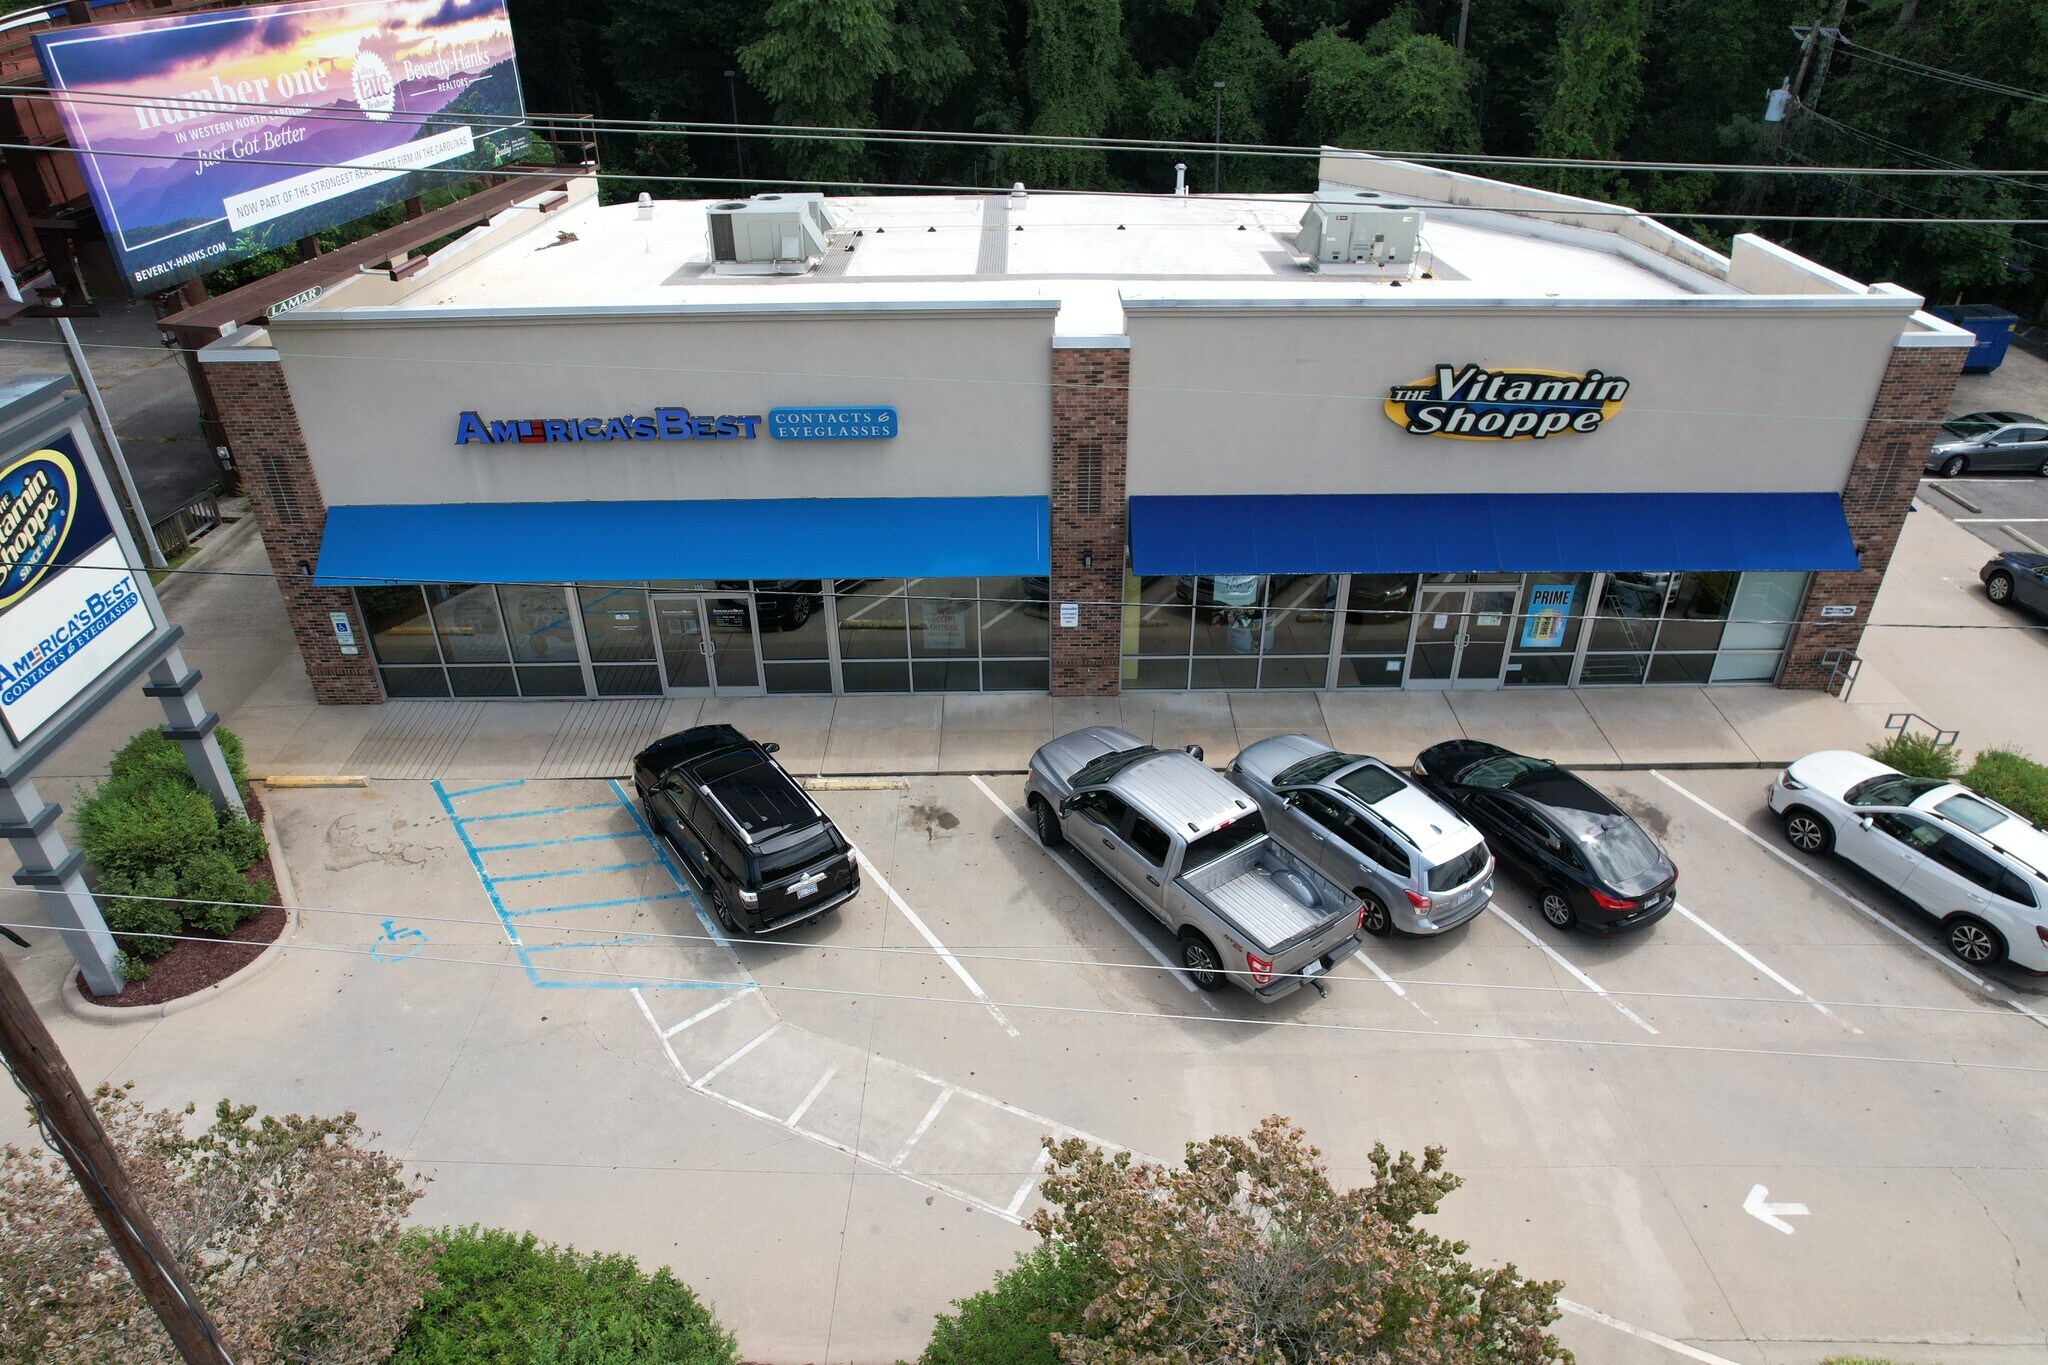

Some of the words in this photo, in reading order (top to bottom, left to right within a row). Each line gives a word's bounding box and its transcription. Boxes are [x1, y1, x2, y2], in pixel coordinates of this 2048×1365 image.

[403, 45, 490, 82] Beverly-Hanks
[134, 75, 269, 130] number
[277, 66, 329, 99] one
[356, 68, 391, 100] tate
[174, 131, 188, 144] IN
[189, 120, 235, 141] WESTERN
[235, 113, 267, 129] NORTH
[195, 142, 229, 176] Just
[232, 134, 260, 159] Got
[264, 125, 306, 151] Better
[236, 202, 258, 219] NOW
[260, 194, 281, 211] PART
[283, 190, 293, 203] OF
[294, 185, 310, 199] THE
[311, 169, 354, 194] STRONGEST
[355, 168, 372, 180] REAL
[372, 157, 397, 174] ESTATE
[397, 153, 414, 167] FIRM
[414, 151, 422, 161] IN
[422, 146, 434, 157] THE
[435, 135, 468, 154] CAROLINAS
[134, 241, 228, 283] BEVERLY-HANKS.COM
[270, 287, 317, 318] LAMAR
[1393, 388, 1432, 401] THE
[1437, 365, 1630, 402] Vitamin
[775, 412, 871, 424] CONTACTS
[877, 411, 890, 424] &
[778, 426, 890, 437] EYEGLASSES
[1408, 405, 1603, 439] Shoppe
[19, 545, 44, 582] SINCE
[42, 523, 57, 549] 1977
[1532, 590, 1571, 605] PRIME
[4, 649, 66, 703] CONTACTS
[67, 642, 76, 655] &
[76, 594, 137, 646] EYEGLASSES
